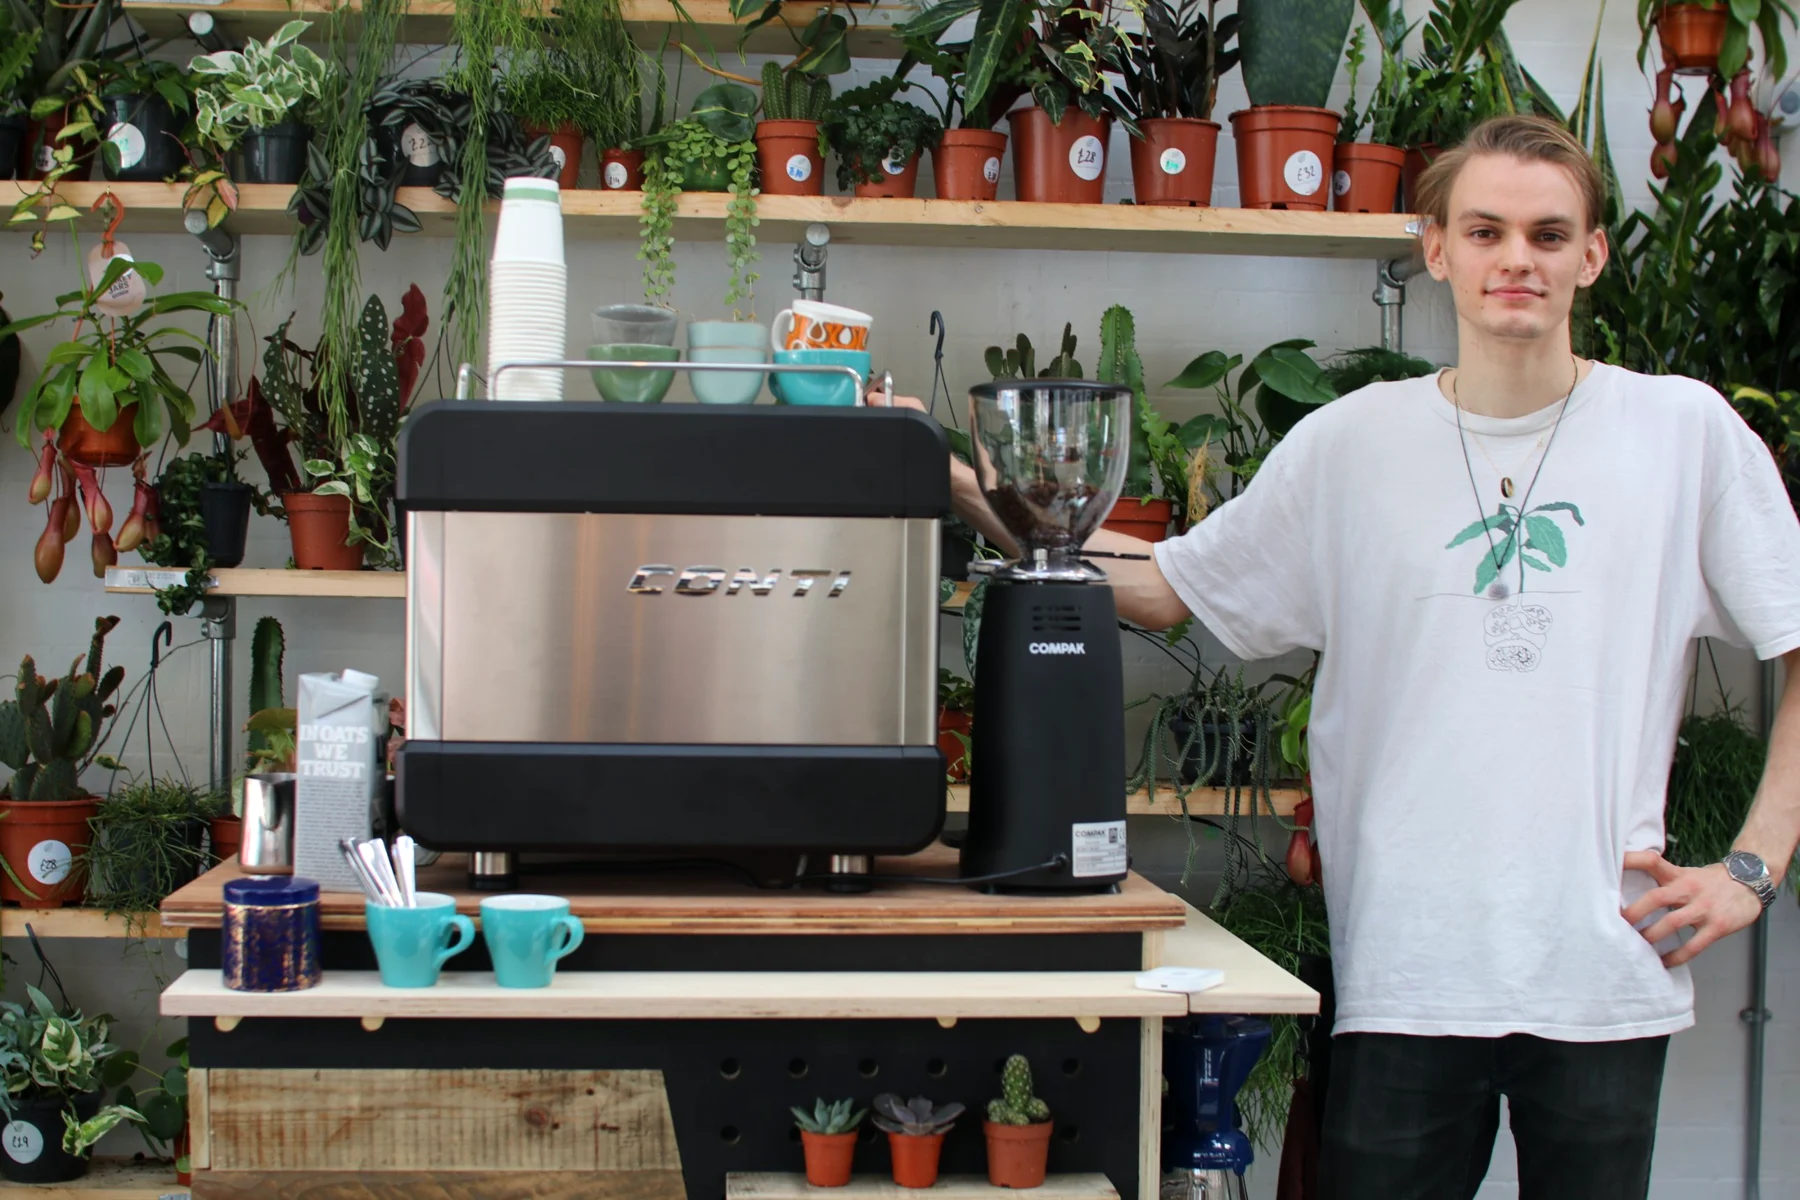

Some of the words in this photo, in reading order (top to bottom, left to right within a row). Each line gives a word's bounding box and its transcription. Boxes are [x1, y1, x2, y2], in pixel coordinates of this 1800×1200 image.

[1077, 148, 1097, 164] £28
[1297, 165, 1316, 182] £32
[109, 281, 129, 295] JARS
[626, 564, 852, 598] CONTI
[1029, 642, 1086, 655] COMPAK
[300, 724, 317, 742] IN
[318, 726, 369, 744] OATS
[313, 742, 348, 761] WE
[301, 760, 365, 779] TRUST
[1075, 830, 1105, 838] COMPAK
[40, 859, 57, 872] £28
[12, 1135, 29, 1148] £19
